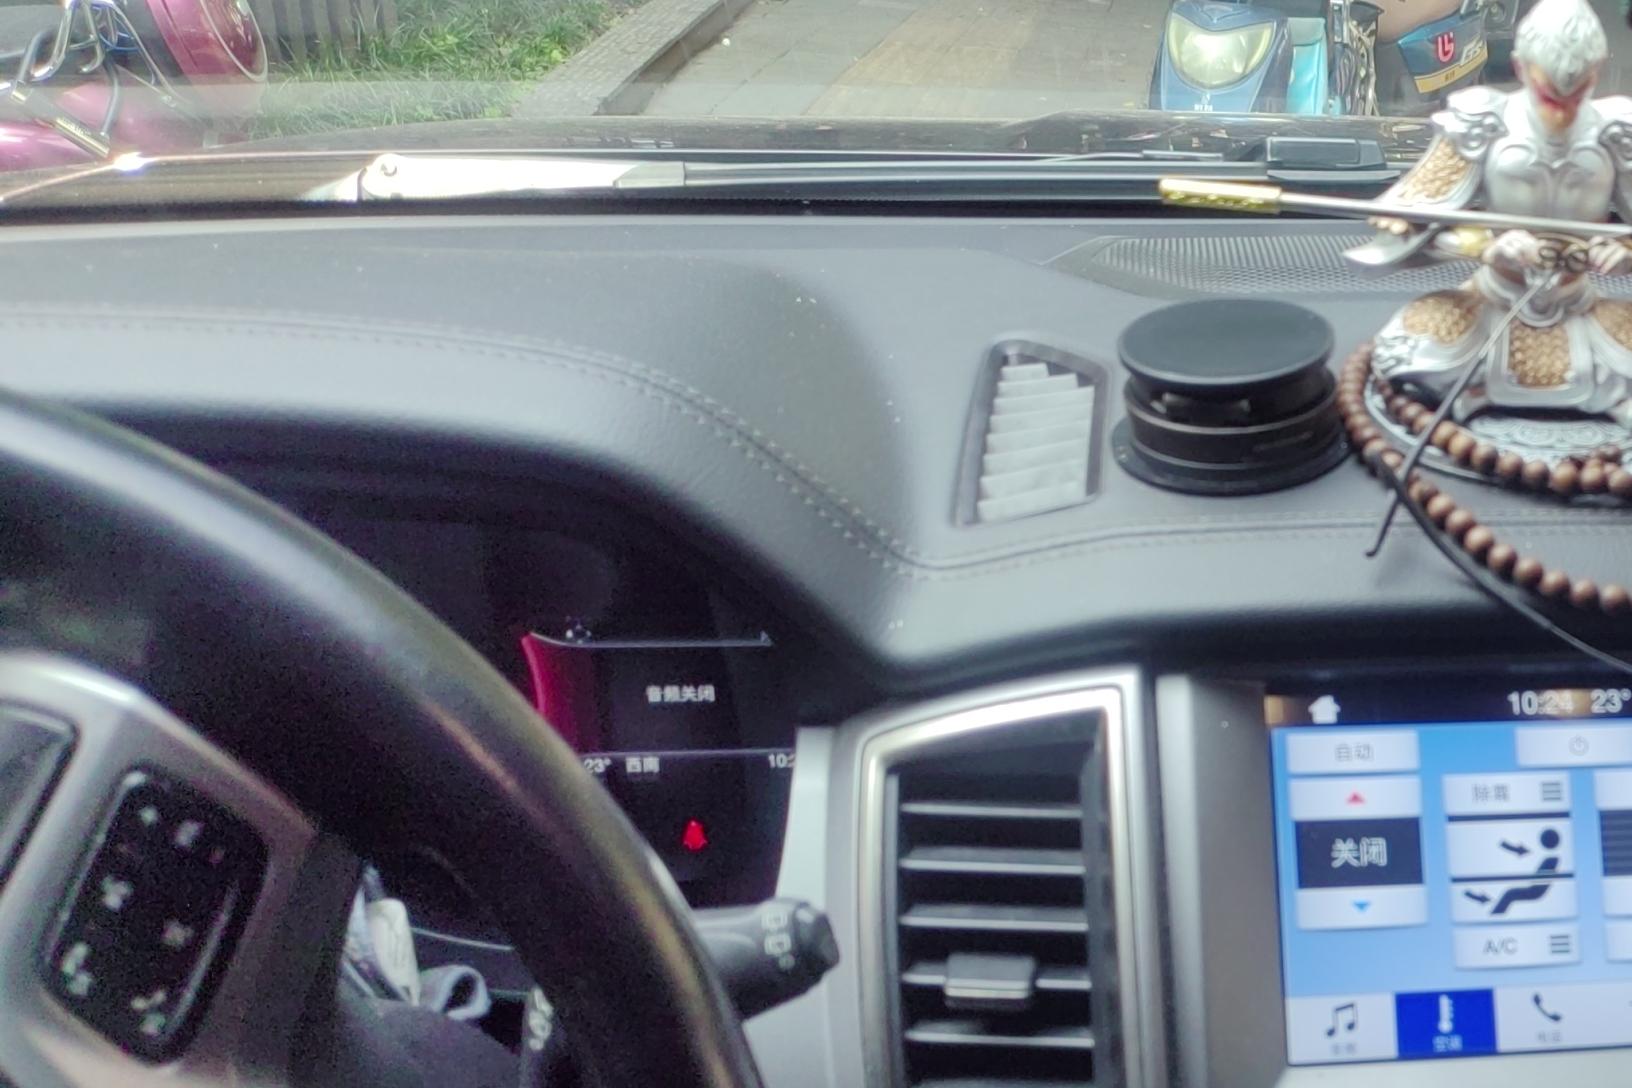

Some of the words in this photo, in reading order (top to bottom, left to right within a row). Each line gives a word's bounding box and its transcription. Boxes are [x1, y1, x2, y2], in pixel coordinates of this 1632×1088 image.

[1507, 690, 1573, 716] 10:24
[1335, 743, 1374, 762] 自动
[1330, 836, 1388, 868] 关闭
[1482, 937, 1518, 955] A/C
